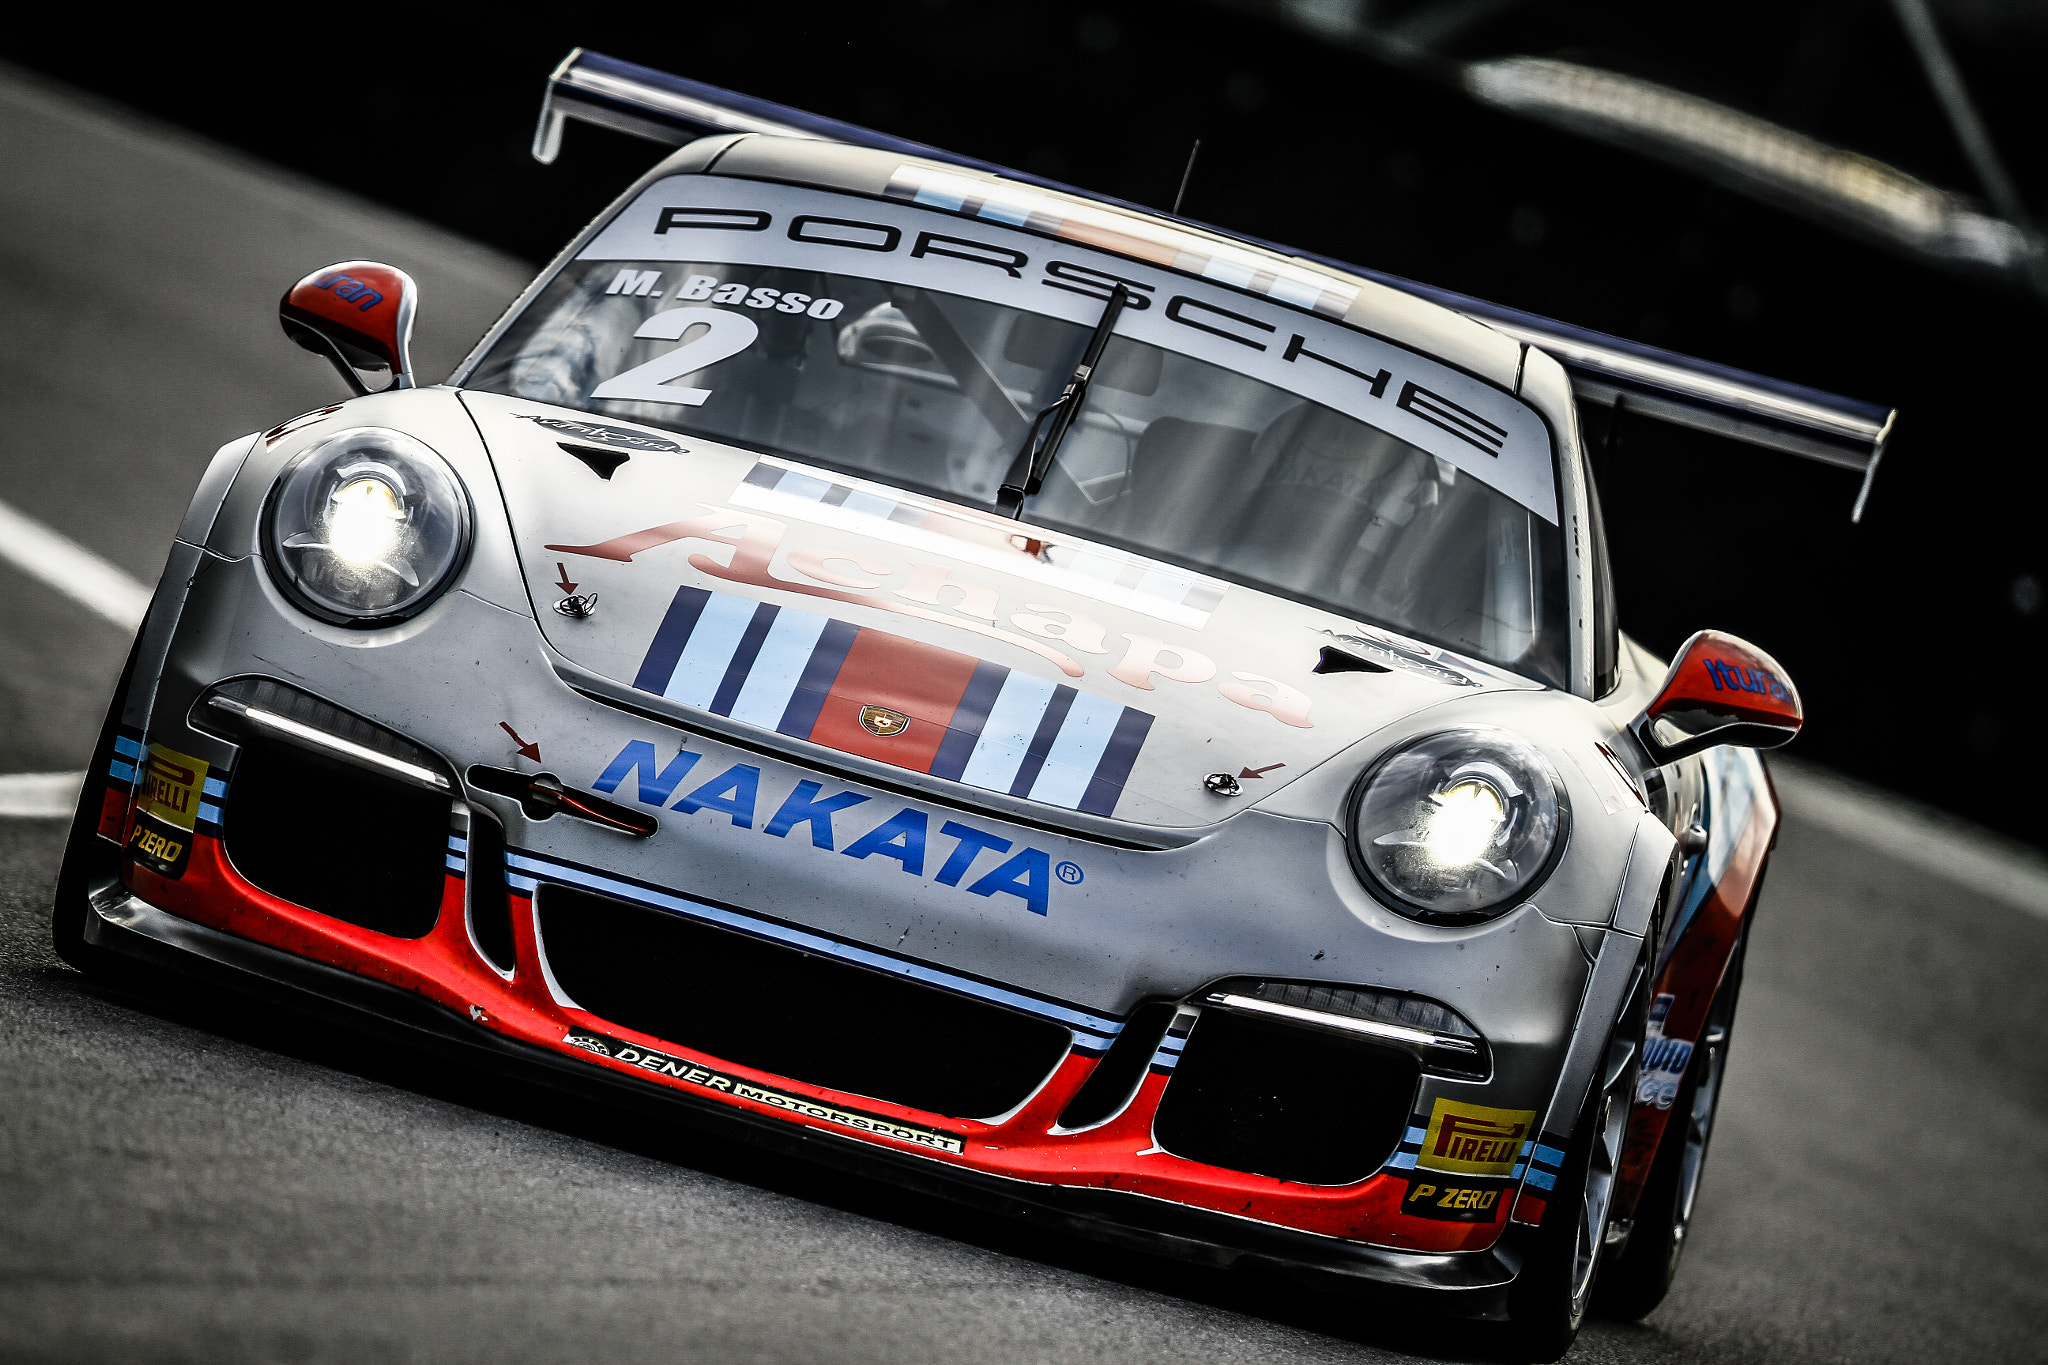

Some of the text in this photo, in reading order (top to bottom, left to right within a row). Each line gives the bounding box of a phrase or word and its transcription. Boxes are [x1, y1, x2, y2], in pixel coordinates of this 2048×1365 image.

[605, 268, 845, 320] M. Basso
[654, 206, 1509, 459] PORSCHE
[590, 306, 759, 407] 2
[544, 503, 1314, 729] Achapa
[129, 823, 183, 863] P ZERO
[591, 739, 1051, 917] NAKATA
[614, 1047, 955, 1150] DENER MOTORSPORT
[1432, 1113, 1526, 1164] PIRELLI
[1408, 1183, 1498, 1210] P ZERO
